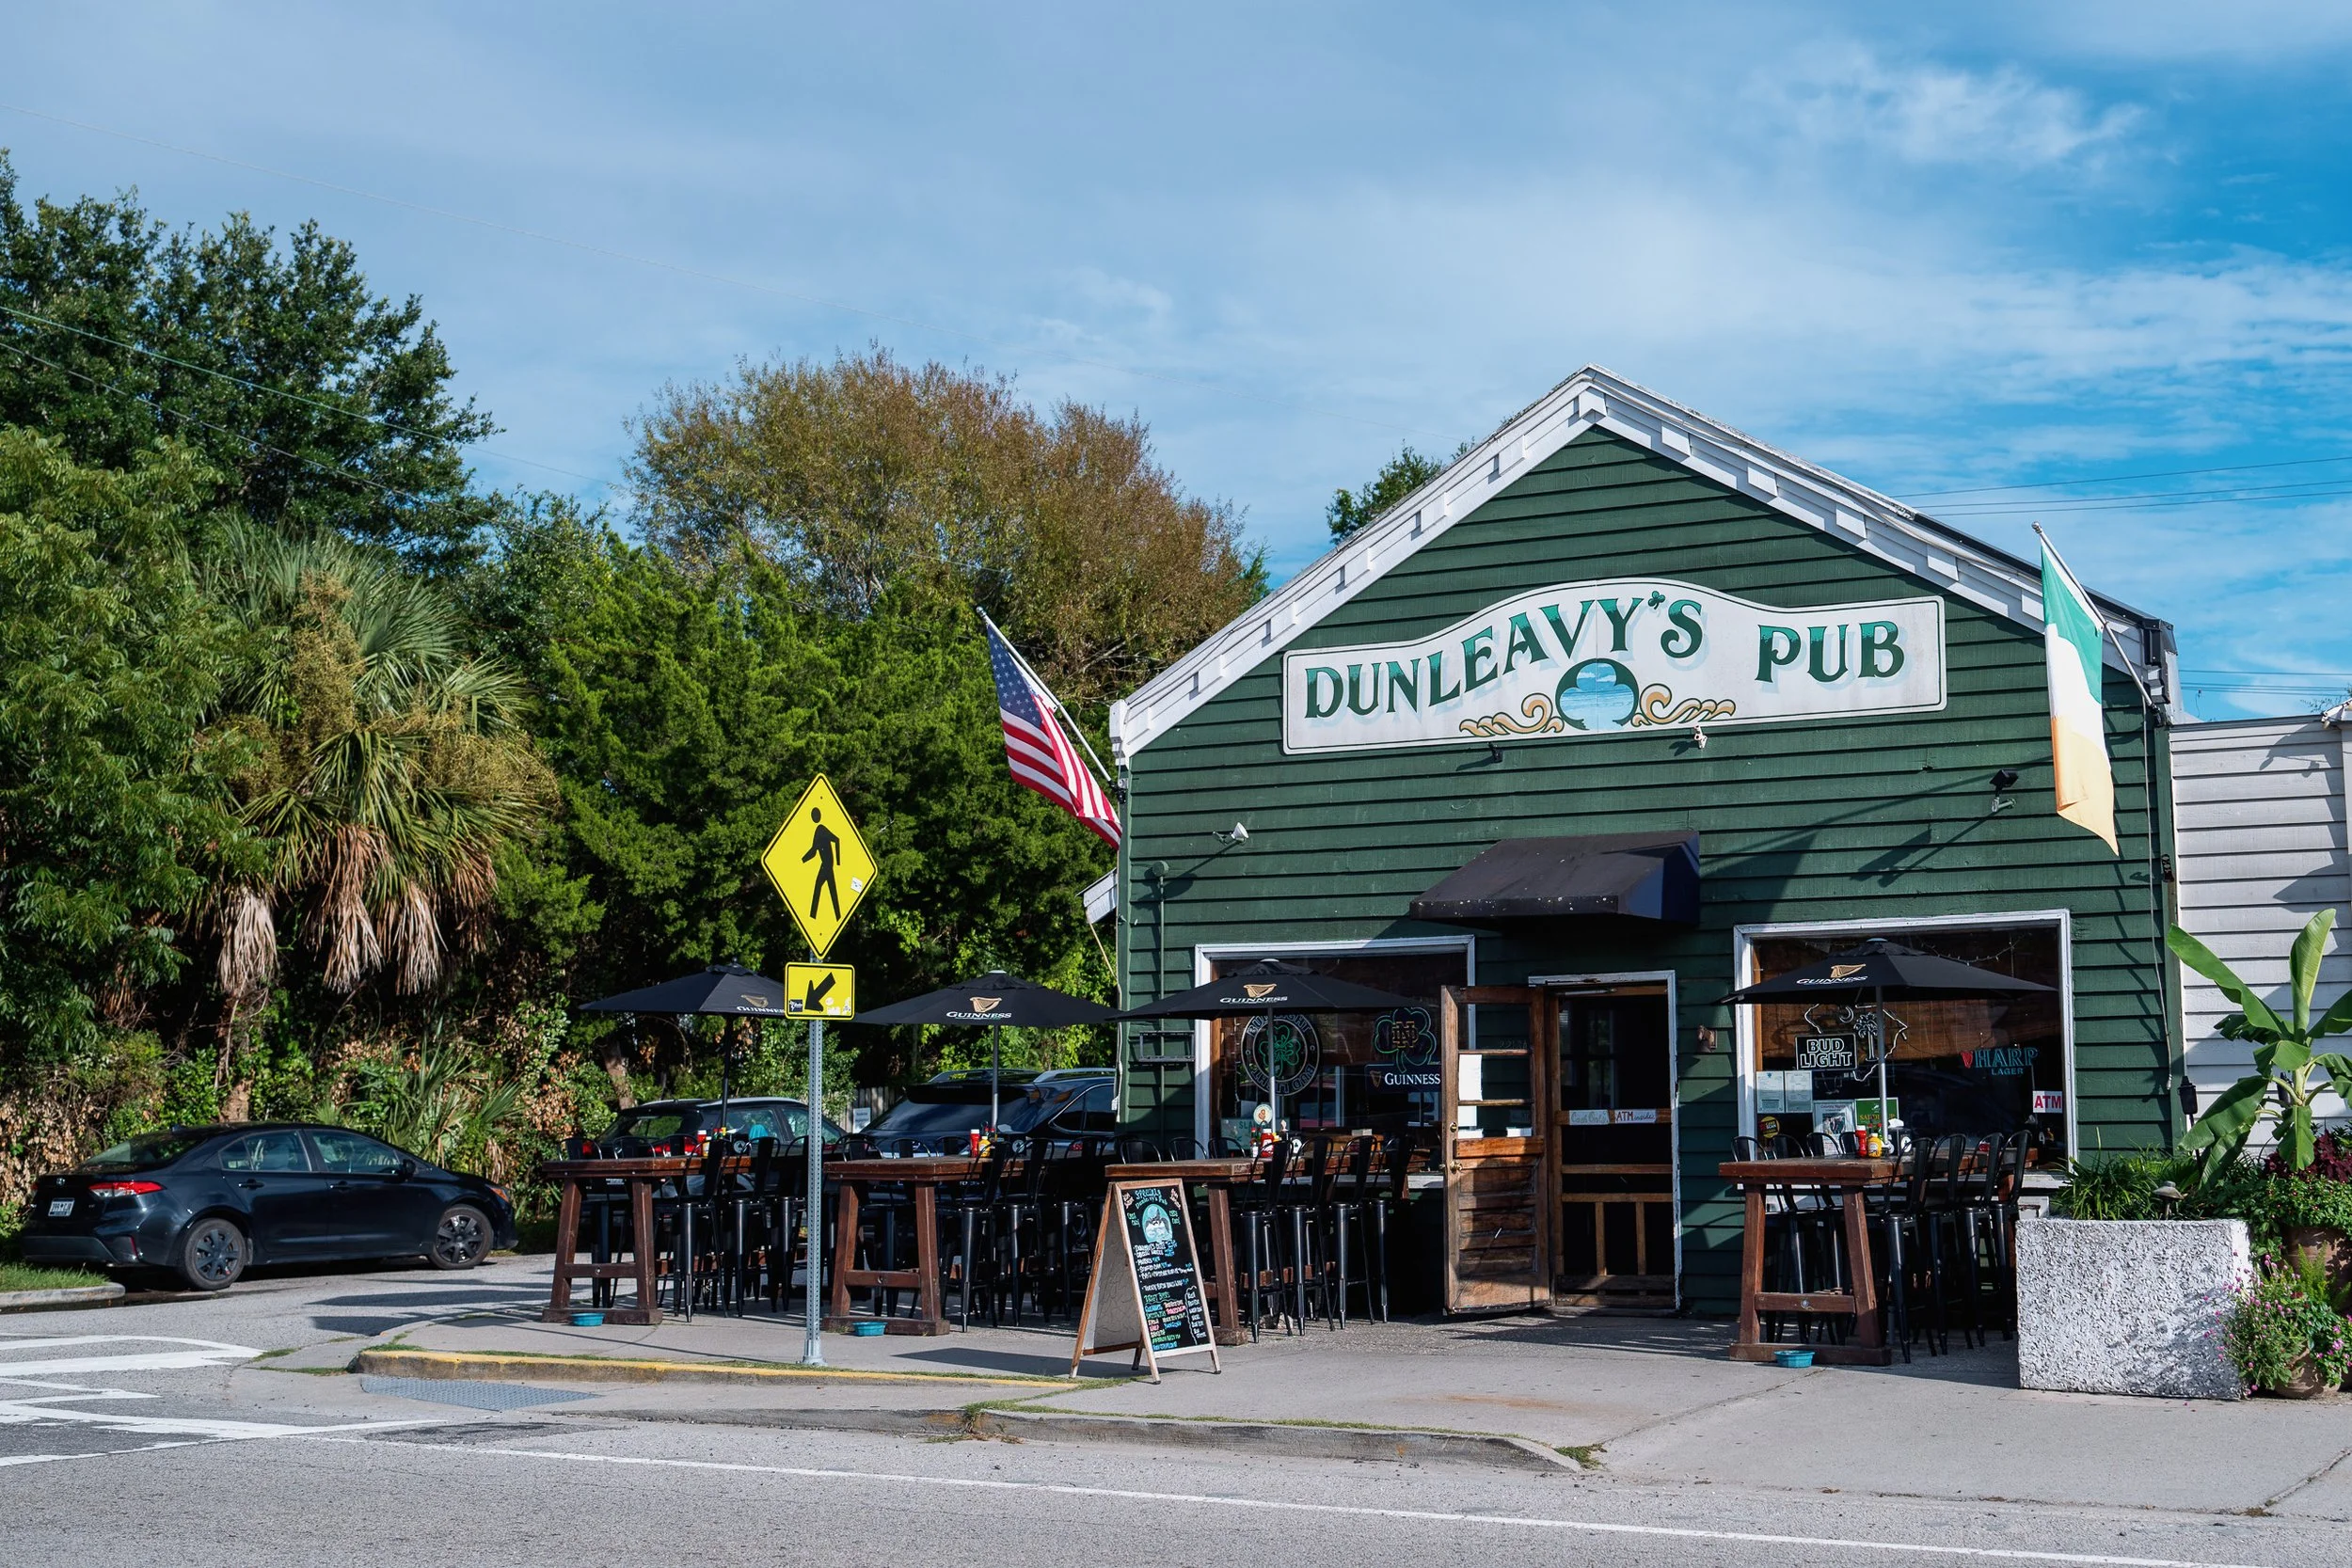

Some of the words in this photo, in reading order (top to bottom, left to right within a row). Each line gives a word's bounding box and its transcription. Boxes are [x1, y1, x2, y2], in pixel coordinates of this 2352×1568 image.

[1305, 591, 1703, 719] DUNLEAVY'S
[1755, 620, 1905, 683] PUB
[1797, 975, 1868, 985] GUINNESS
[737, 1006, 786, 1014] GUINNES
[1806, 1037, 1845, 1054] BUD
[1800, 1052, 1852, 1069] LIGHT
[1975, 1047, 2040, 1068] HARP
[1384, 1072, 1441, 1085] GUINNESS
[1991, 1068, 2025, 1076] LAGER
[2034, 1095, 2062, 1109] ATM
[1615, 1111, 1634, 1122] ATM
